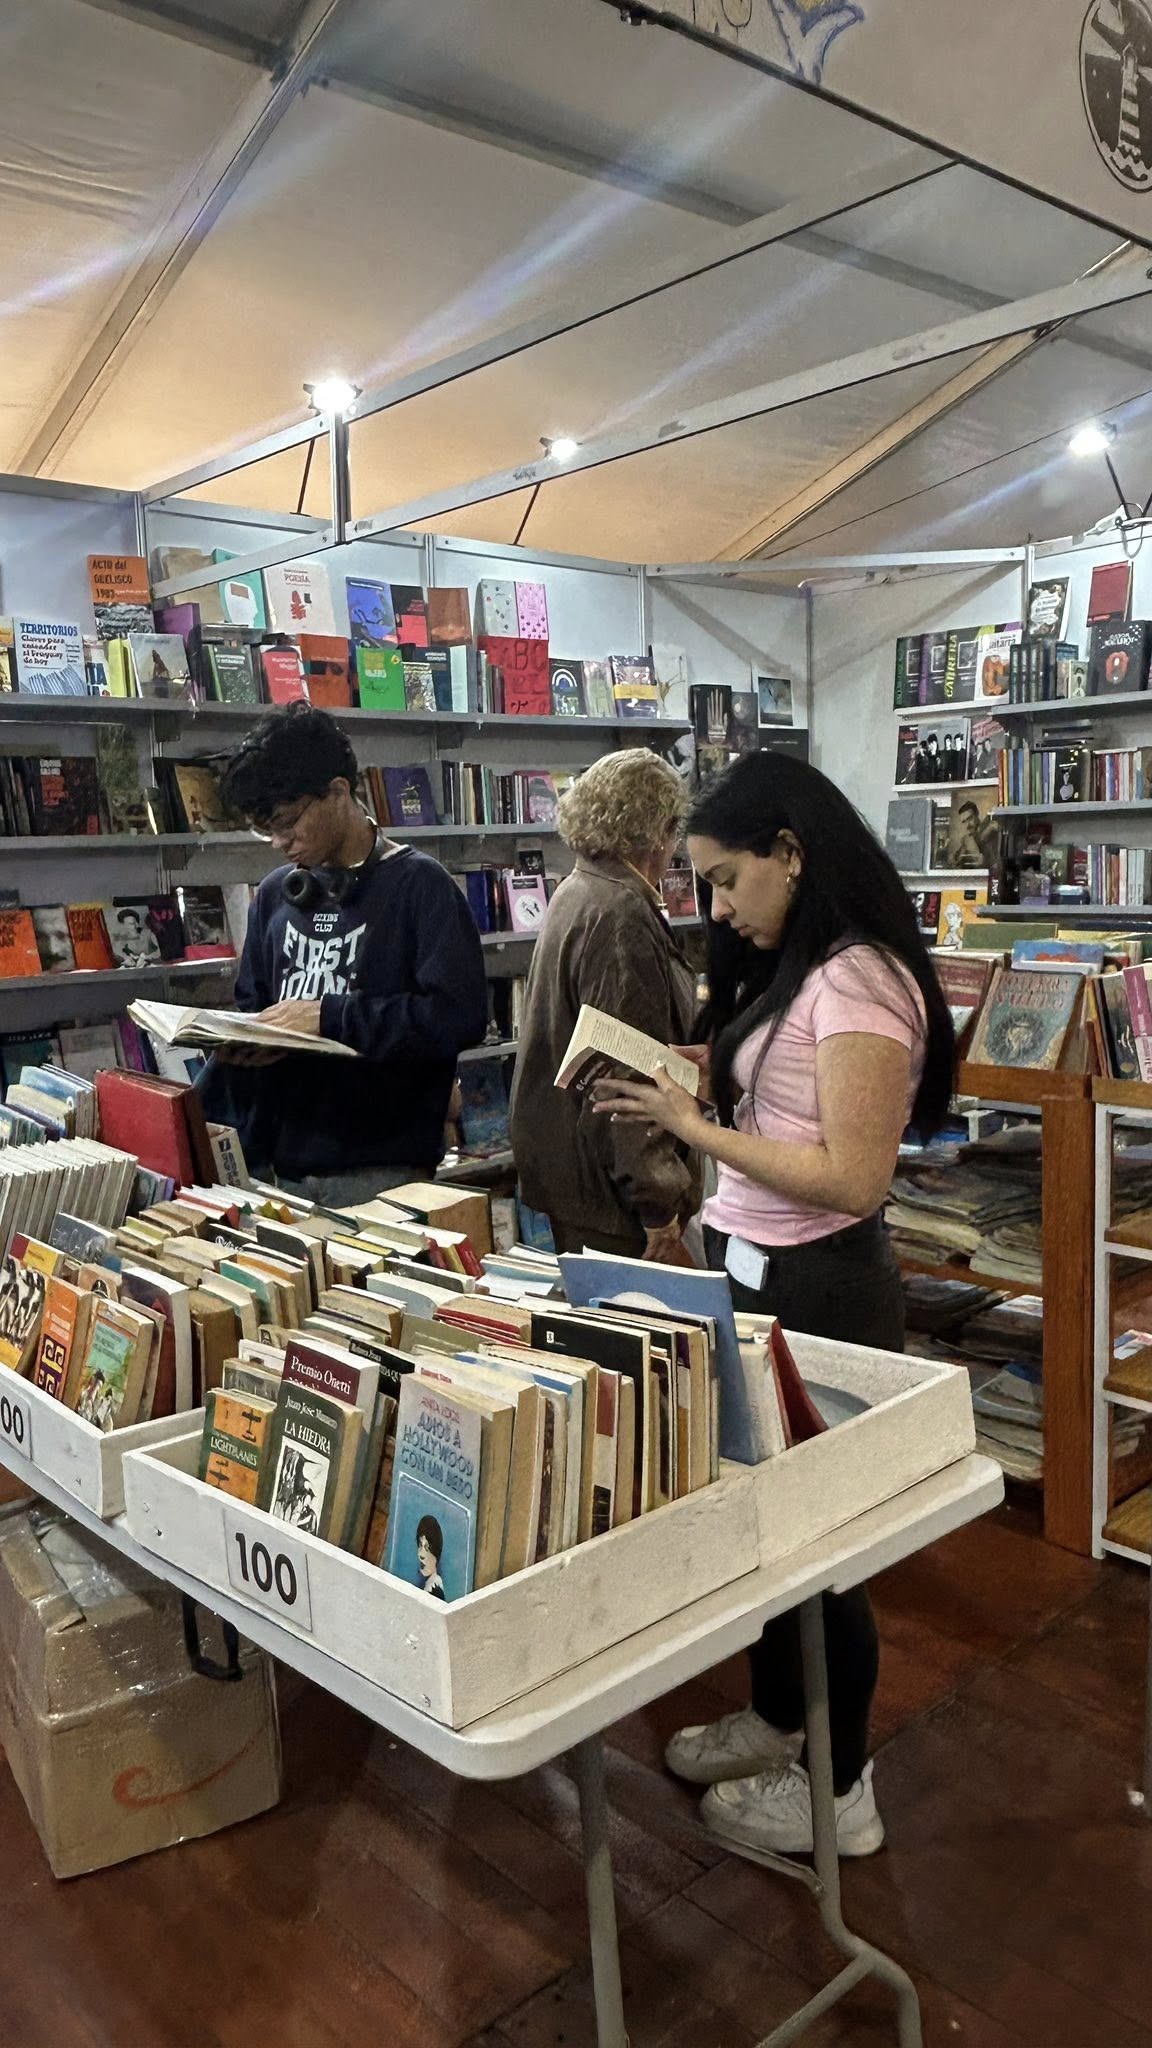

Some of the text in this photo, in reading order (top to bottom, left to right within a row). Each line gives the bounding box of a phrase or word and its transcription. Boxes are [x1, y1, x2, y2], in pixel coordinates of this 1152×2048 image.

[20, 623, 78, 637] TERRITORIOS
[282, 919, 367, 974] FIRST
[291, 1355, 323, 1381] Premio
[323, 1369, 352, 1395] Onetti
[284, 1418, 296, 1437] LA
[297, 1424, 331, 1455] HIEDRA
[235, 1531, 298, 1606] 100
